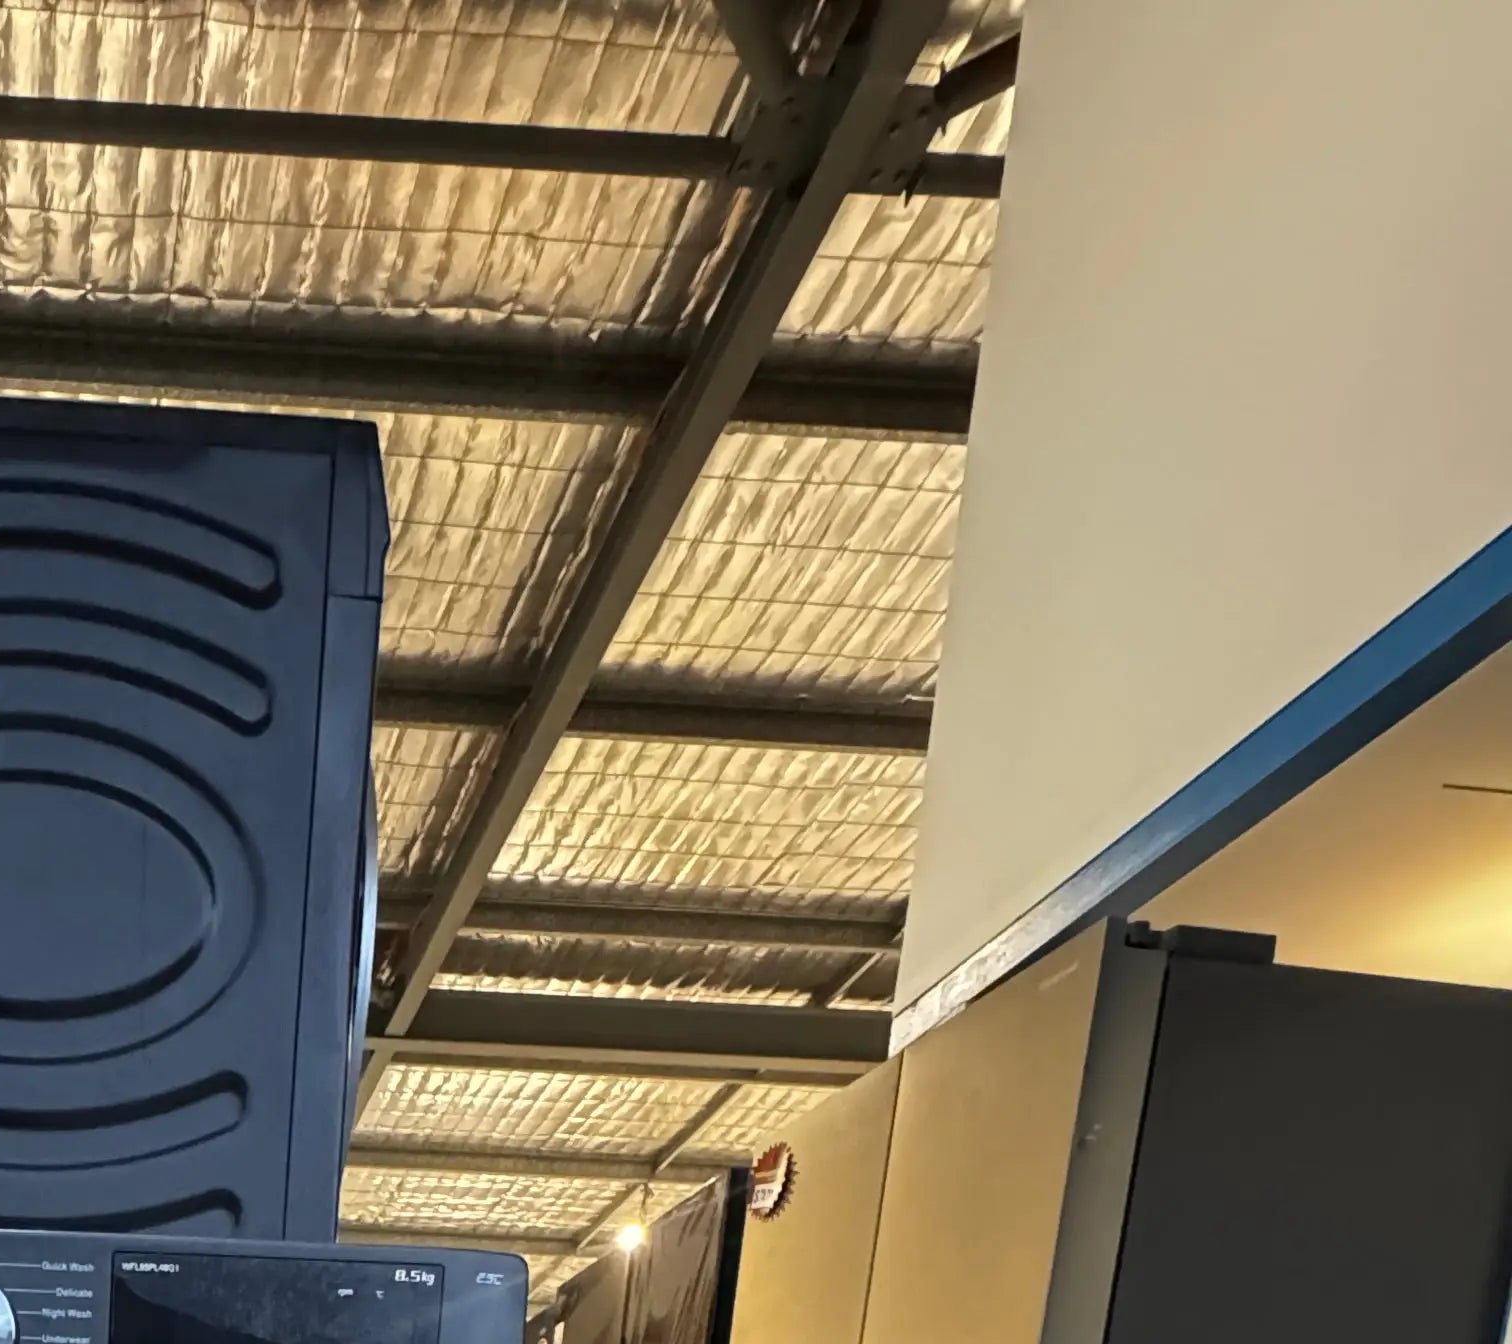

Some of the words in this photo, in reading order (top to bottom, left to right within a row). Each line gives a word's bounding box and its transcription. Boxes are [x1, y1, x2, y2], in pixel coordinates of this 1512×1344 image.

[42, 1261, 67, 1271] Quick
[69, 1262, 94, 1272] Wash
[394, 1269, 435, 1286] 8.5kg
[56, 1287, 93, 1298] Delicate
[67, 1309, 92, 1318] Wash
[42, 1334, 90, 1344] Underwear
